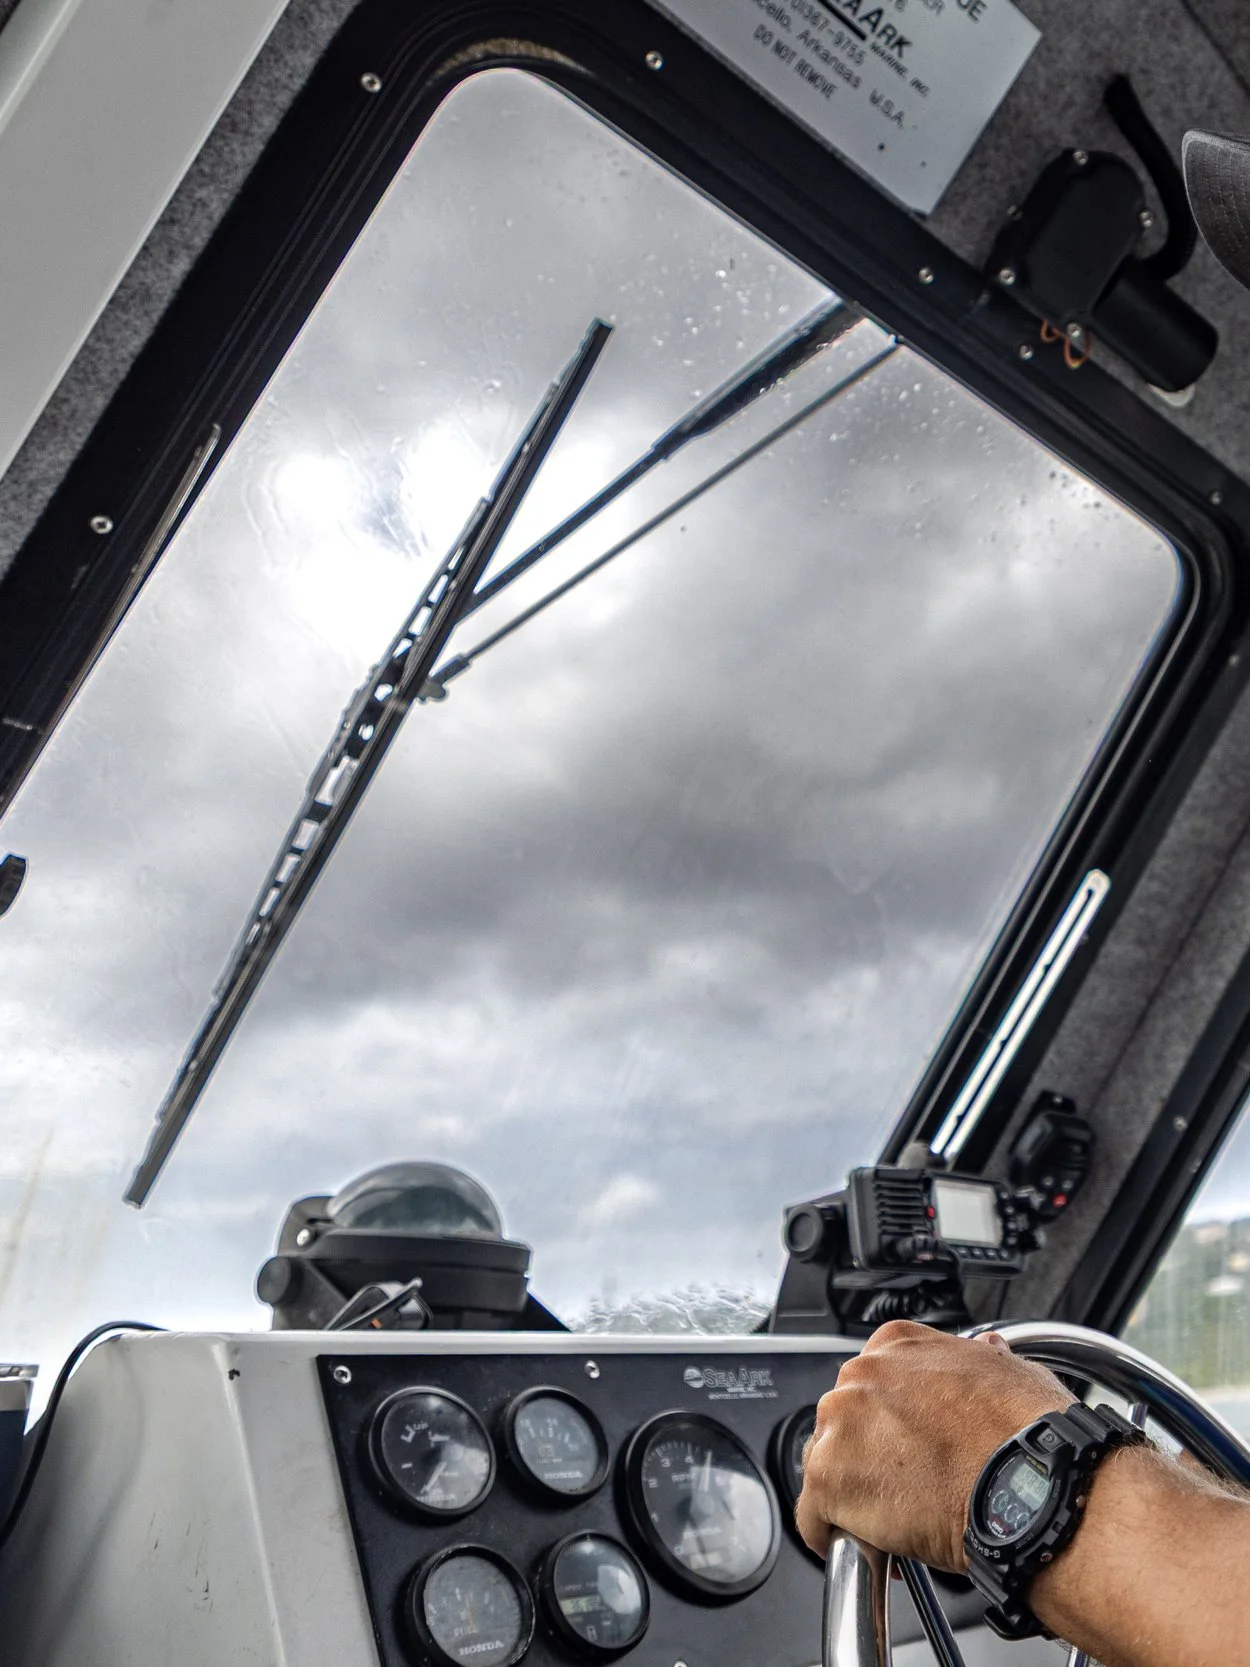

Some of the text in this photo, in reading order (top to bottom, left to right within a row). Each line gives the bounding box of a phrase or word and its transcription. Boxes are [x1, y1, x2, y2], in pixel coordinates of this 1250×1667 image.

[753, 24, 837, 99] DO NOT REMOVE
[796, 29, 862, 90] Arkansas
[660, 1457, 671, 1468] 3
[459, 1640, 505, 1657] HONDA
